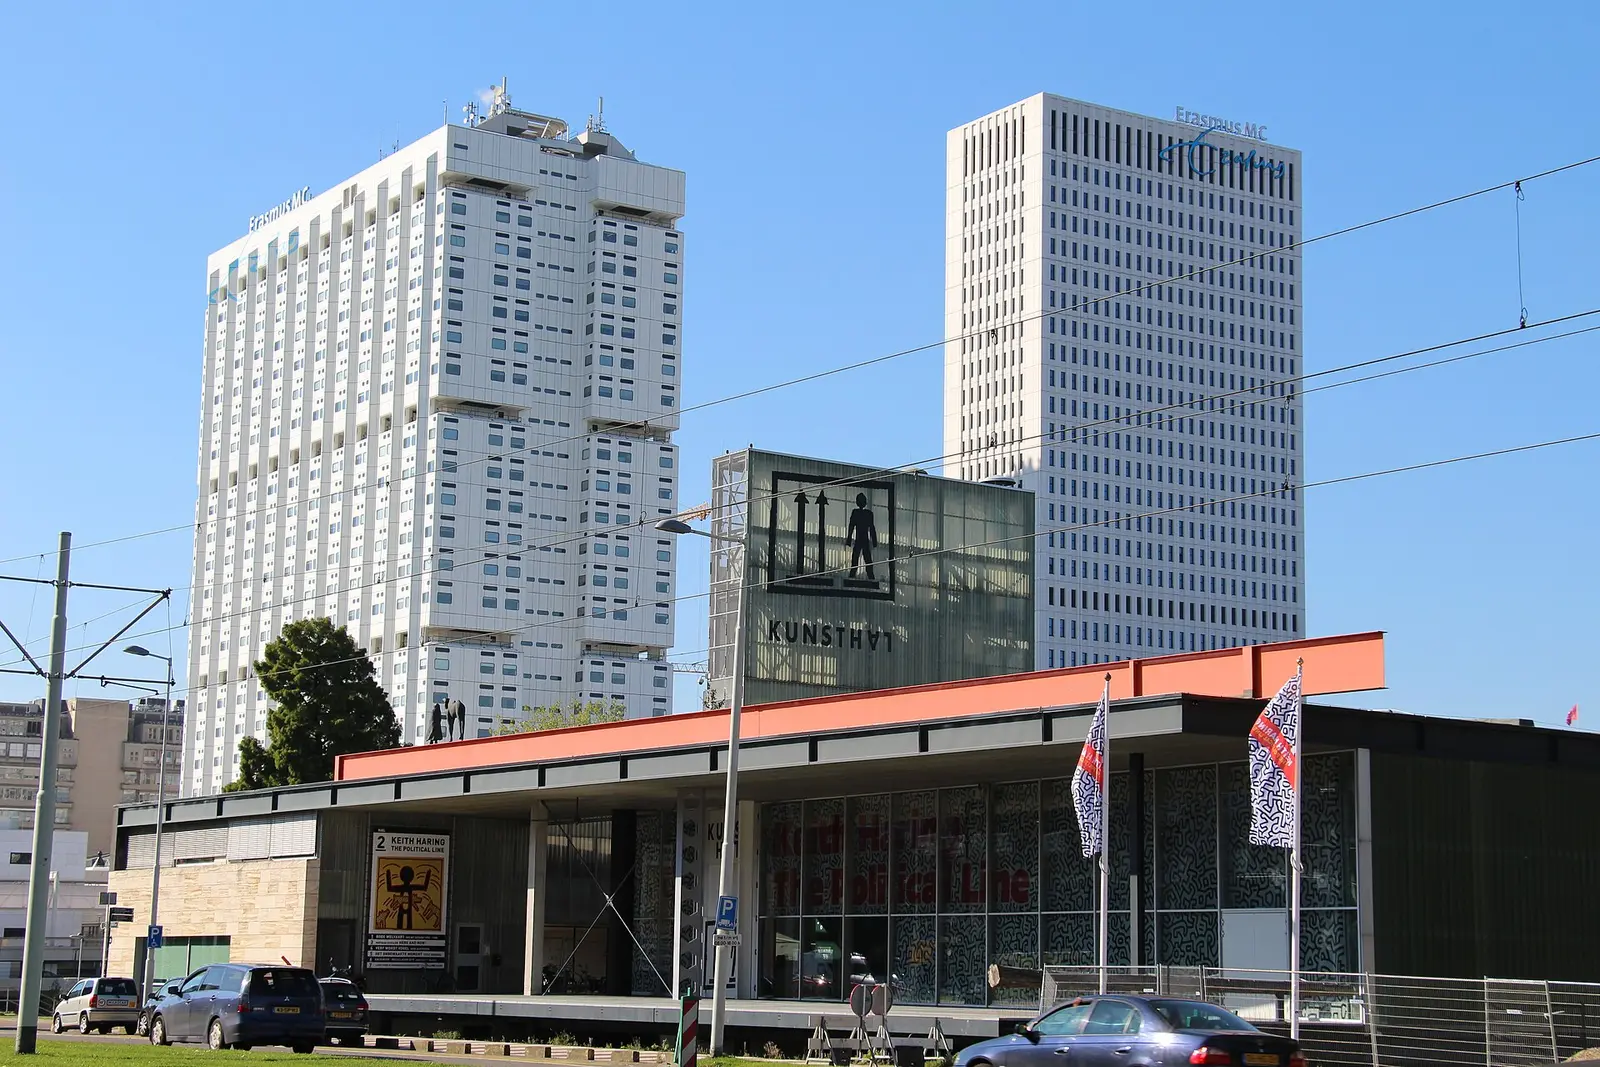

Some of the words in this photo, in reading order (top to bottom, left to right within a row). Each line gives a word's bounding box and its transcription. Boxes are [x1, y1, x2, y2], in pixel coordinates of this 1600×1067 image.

[1176, 106, 1240, 134] Erasmus
[1244, 122, 1268, 140] MC
[250, 198, 292, 232] Erasmus
[292, 186, 310, 210] MC
[768, 620, 892, 652] KUNSTHAL
[377, 836, 385, 848] 2
[722, 900, 733, 915] P
[151, 928, 160, 938] P
